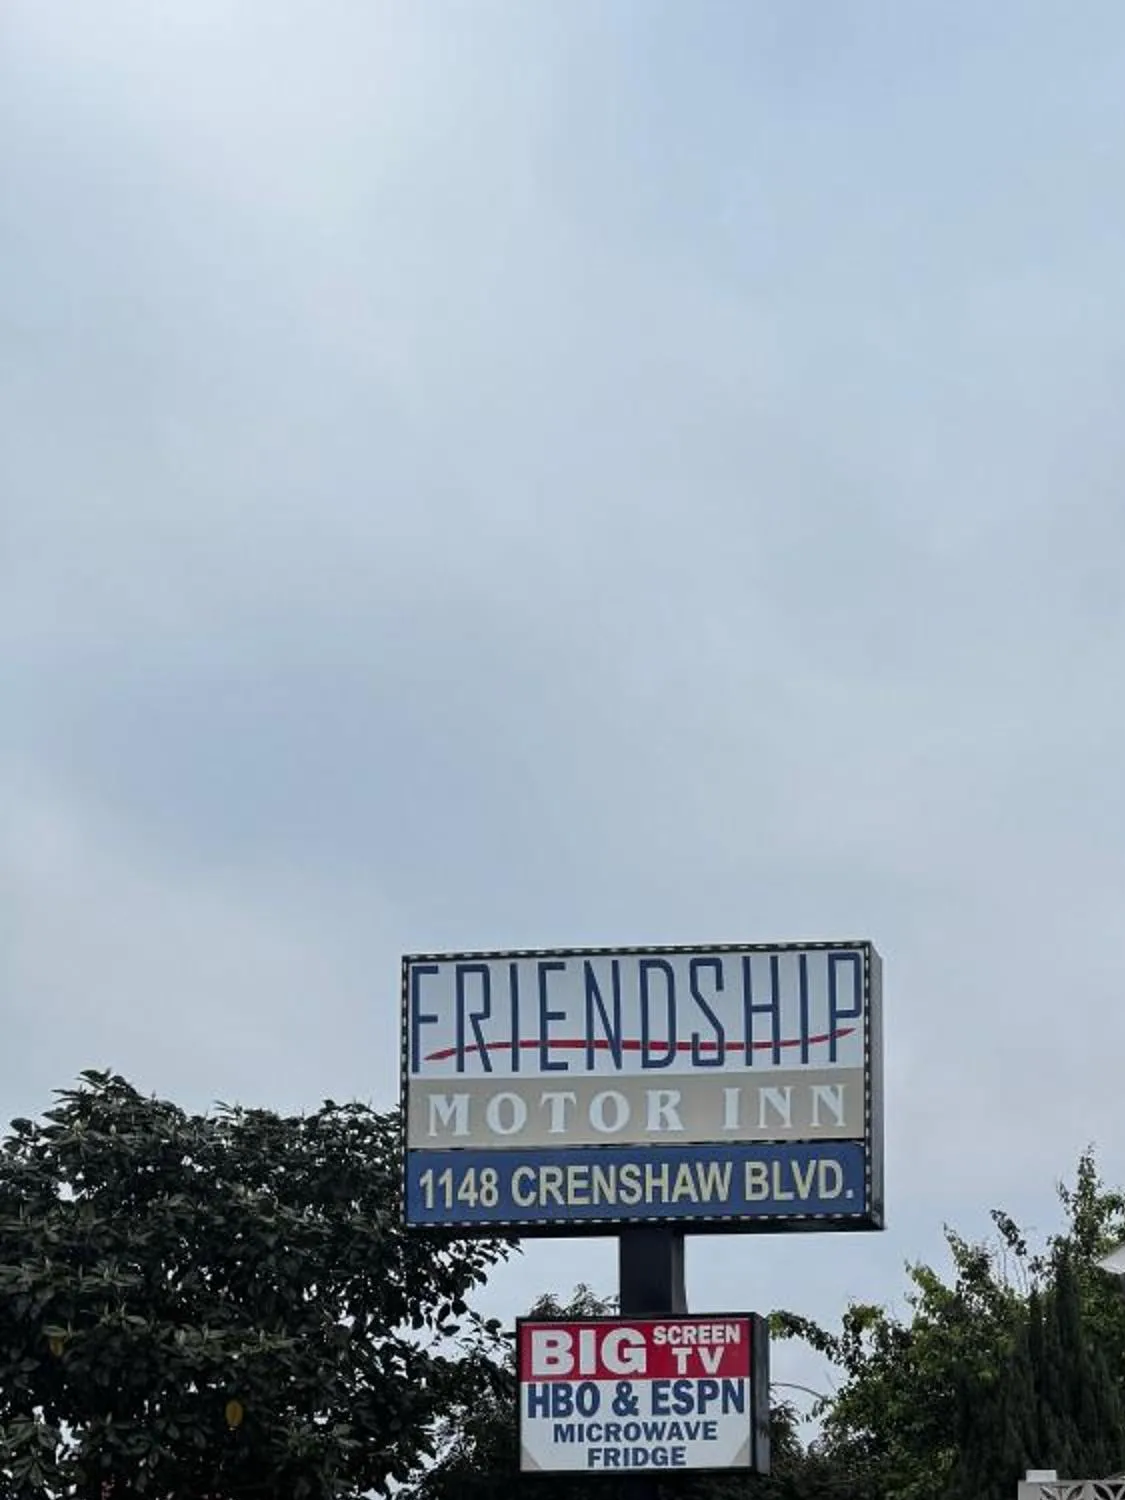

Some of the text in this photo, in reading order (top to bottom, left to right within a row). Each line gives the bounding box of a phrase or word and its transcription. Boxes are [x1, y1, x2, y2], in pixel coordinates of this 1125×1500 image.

[411, 952, 863, 1073] FRIENDSHIP
[428, 1083, 848, 1137] MOTOR INN
[418, 1159, 854, 1210] 1148 CRENSHAW BLVD.
[531, 1327, 647, 1376] BIG
[652, 1324, 741, 1345] SCREEN
[672, 1346, 725, 1375] TV
[527, 1378, 745, 1419] HBO & ESPN
[553, 1421, 718, 1443] MICROWAVE
[587, 1446, 687, 1468] FRIDGE
